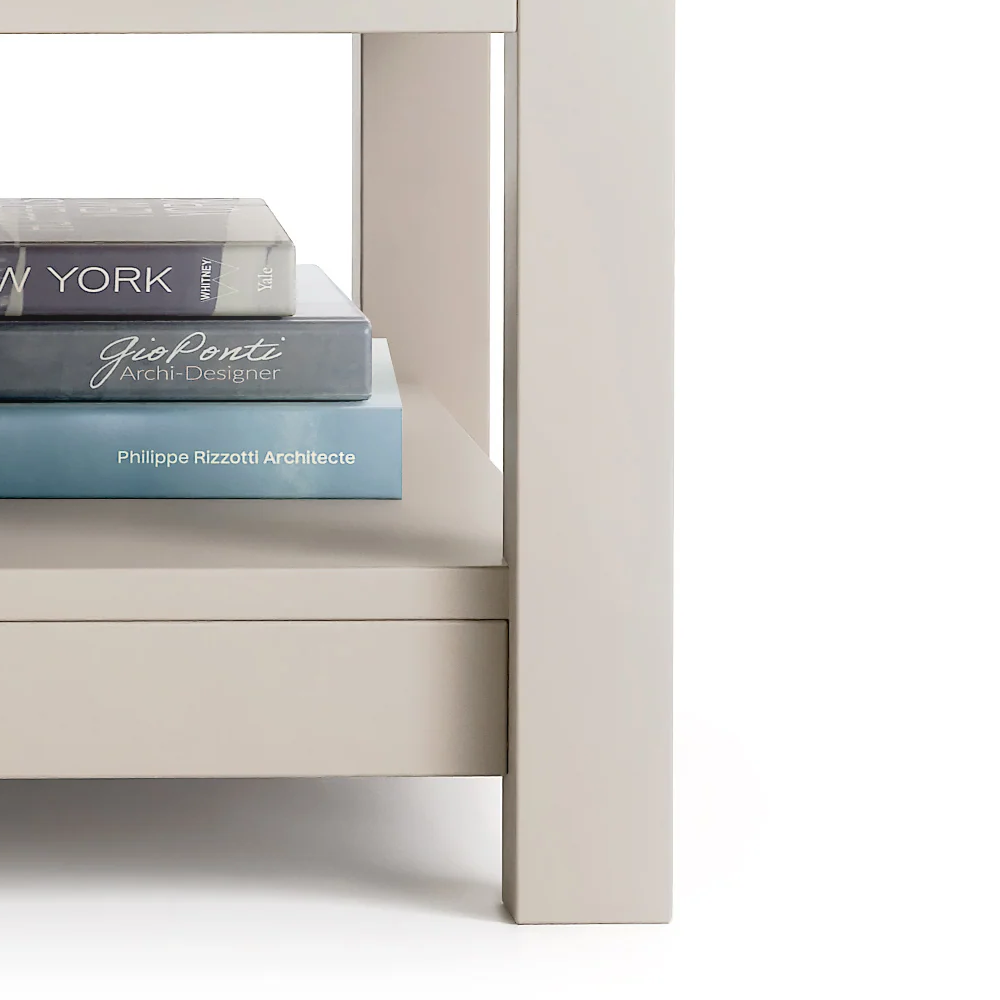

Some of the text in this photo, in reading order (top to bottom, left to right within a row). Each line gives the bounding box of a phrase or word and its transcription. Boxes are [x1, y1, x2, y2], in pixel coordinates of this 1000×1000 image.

[47, 267, 172, 293] YORK
[200, 258, 212, 301] WHITNEY
[257, 267, 273, 292] Yale
[119, 365, 281, 383] Archi-Designer
[117, 450, 356, 467] Philippe Rizzotti Architecte
